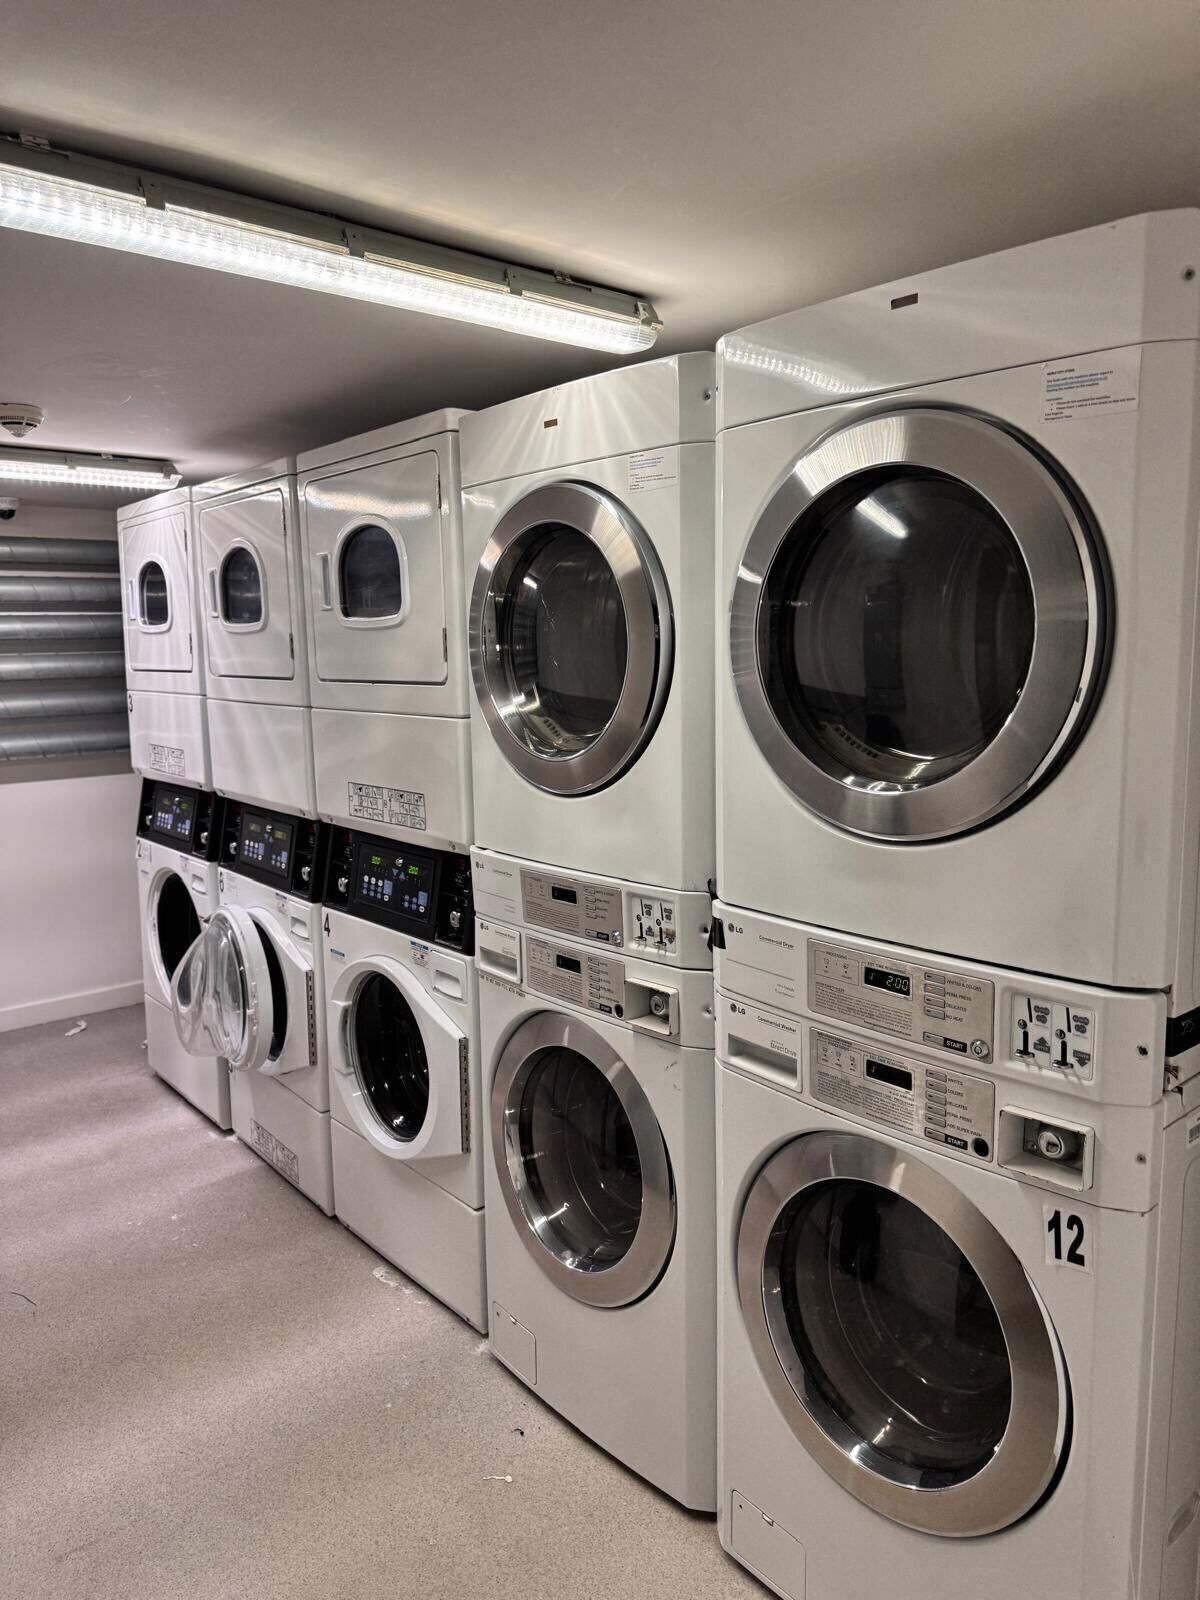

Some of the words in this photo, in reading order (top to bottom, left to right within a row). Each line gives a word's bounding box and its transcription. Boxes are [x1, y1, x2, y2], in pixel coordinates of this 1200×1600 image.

[323, 912, 331, 938] 4
[757, 1015, 781, 1028] Commercial
[781, 1023, 797, 1033] Washer
[946, 1040, 964, 1050] START
[947, 1137, 965, 1147] START
[1047, 1209, 1085, 1268] 12
